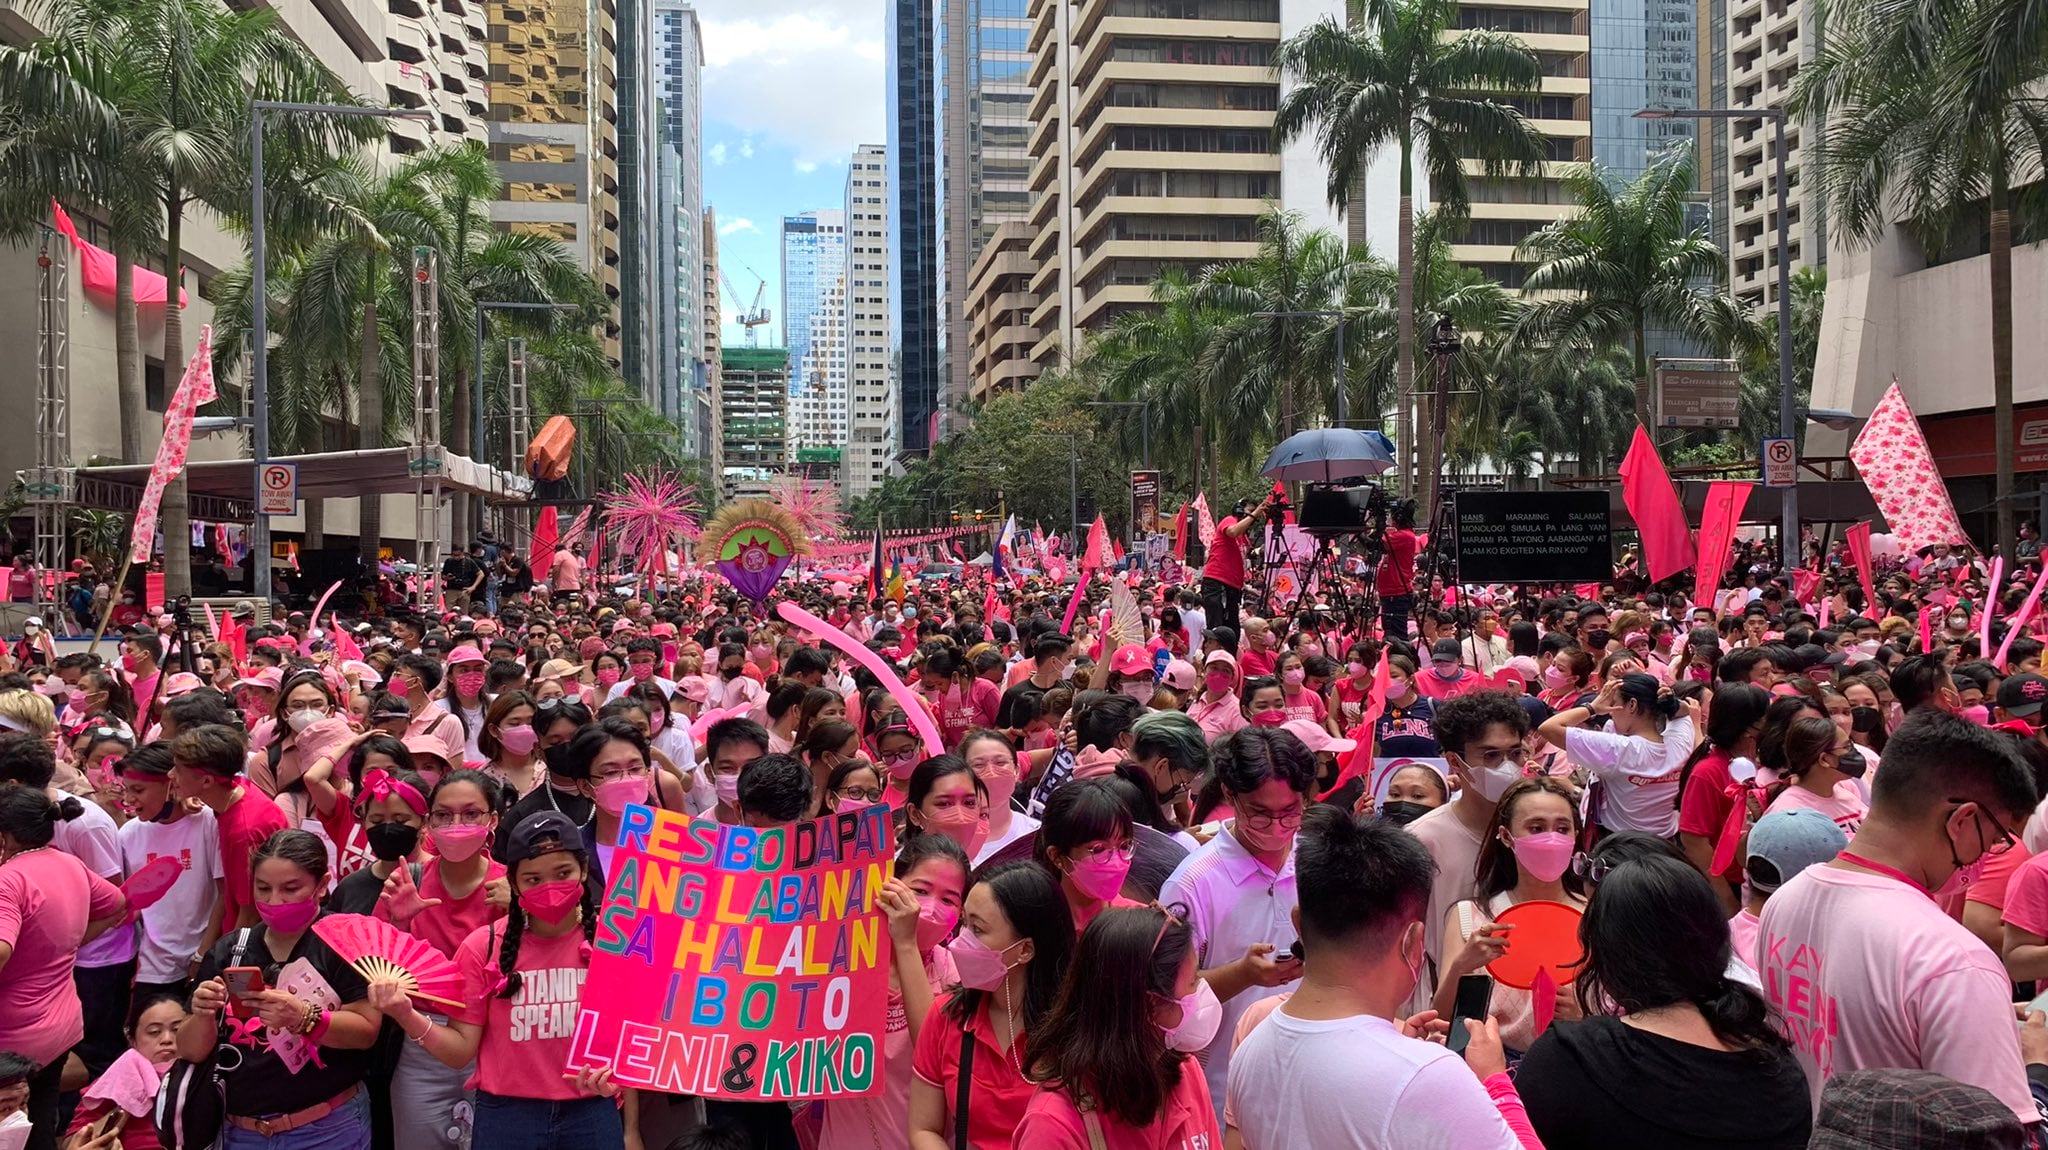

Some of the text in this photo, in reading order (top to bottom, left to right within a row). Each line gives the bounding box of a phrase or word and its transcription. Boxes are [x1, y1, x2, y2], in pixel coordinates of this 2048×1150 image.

[1774, 472, 1791, 480] ZONE
[261, 489, 275, 497] TOW
[268, 498, 287, 506] ZONE
[1505, 513, 1550, 521] MARAMING
[1561, 524, 1583, 532] LANG
[1512, 535, 1545, 543] TAYONG
[1462, 547, 1485, 555] ALAM
[1486, 547, 1498, 555] KO
[1500, 547, 1535, 555] EXCITED
[1536, 547, 1549, 555] NA
[618, 802, 892, 873] RESIBO DAPAT
[608, 858, 894, 924] ANG LABANAN
[595, 905, 880, 976] SA HALALAN
[565, 1009, 875, 1097] LENI & KIKO
